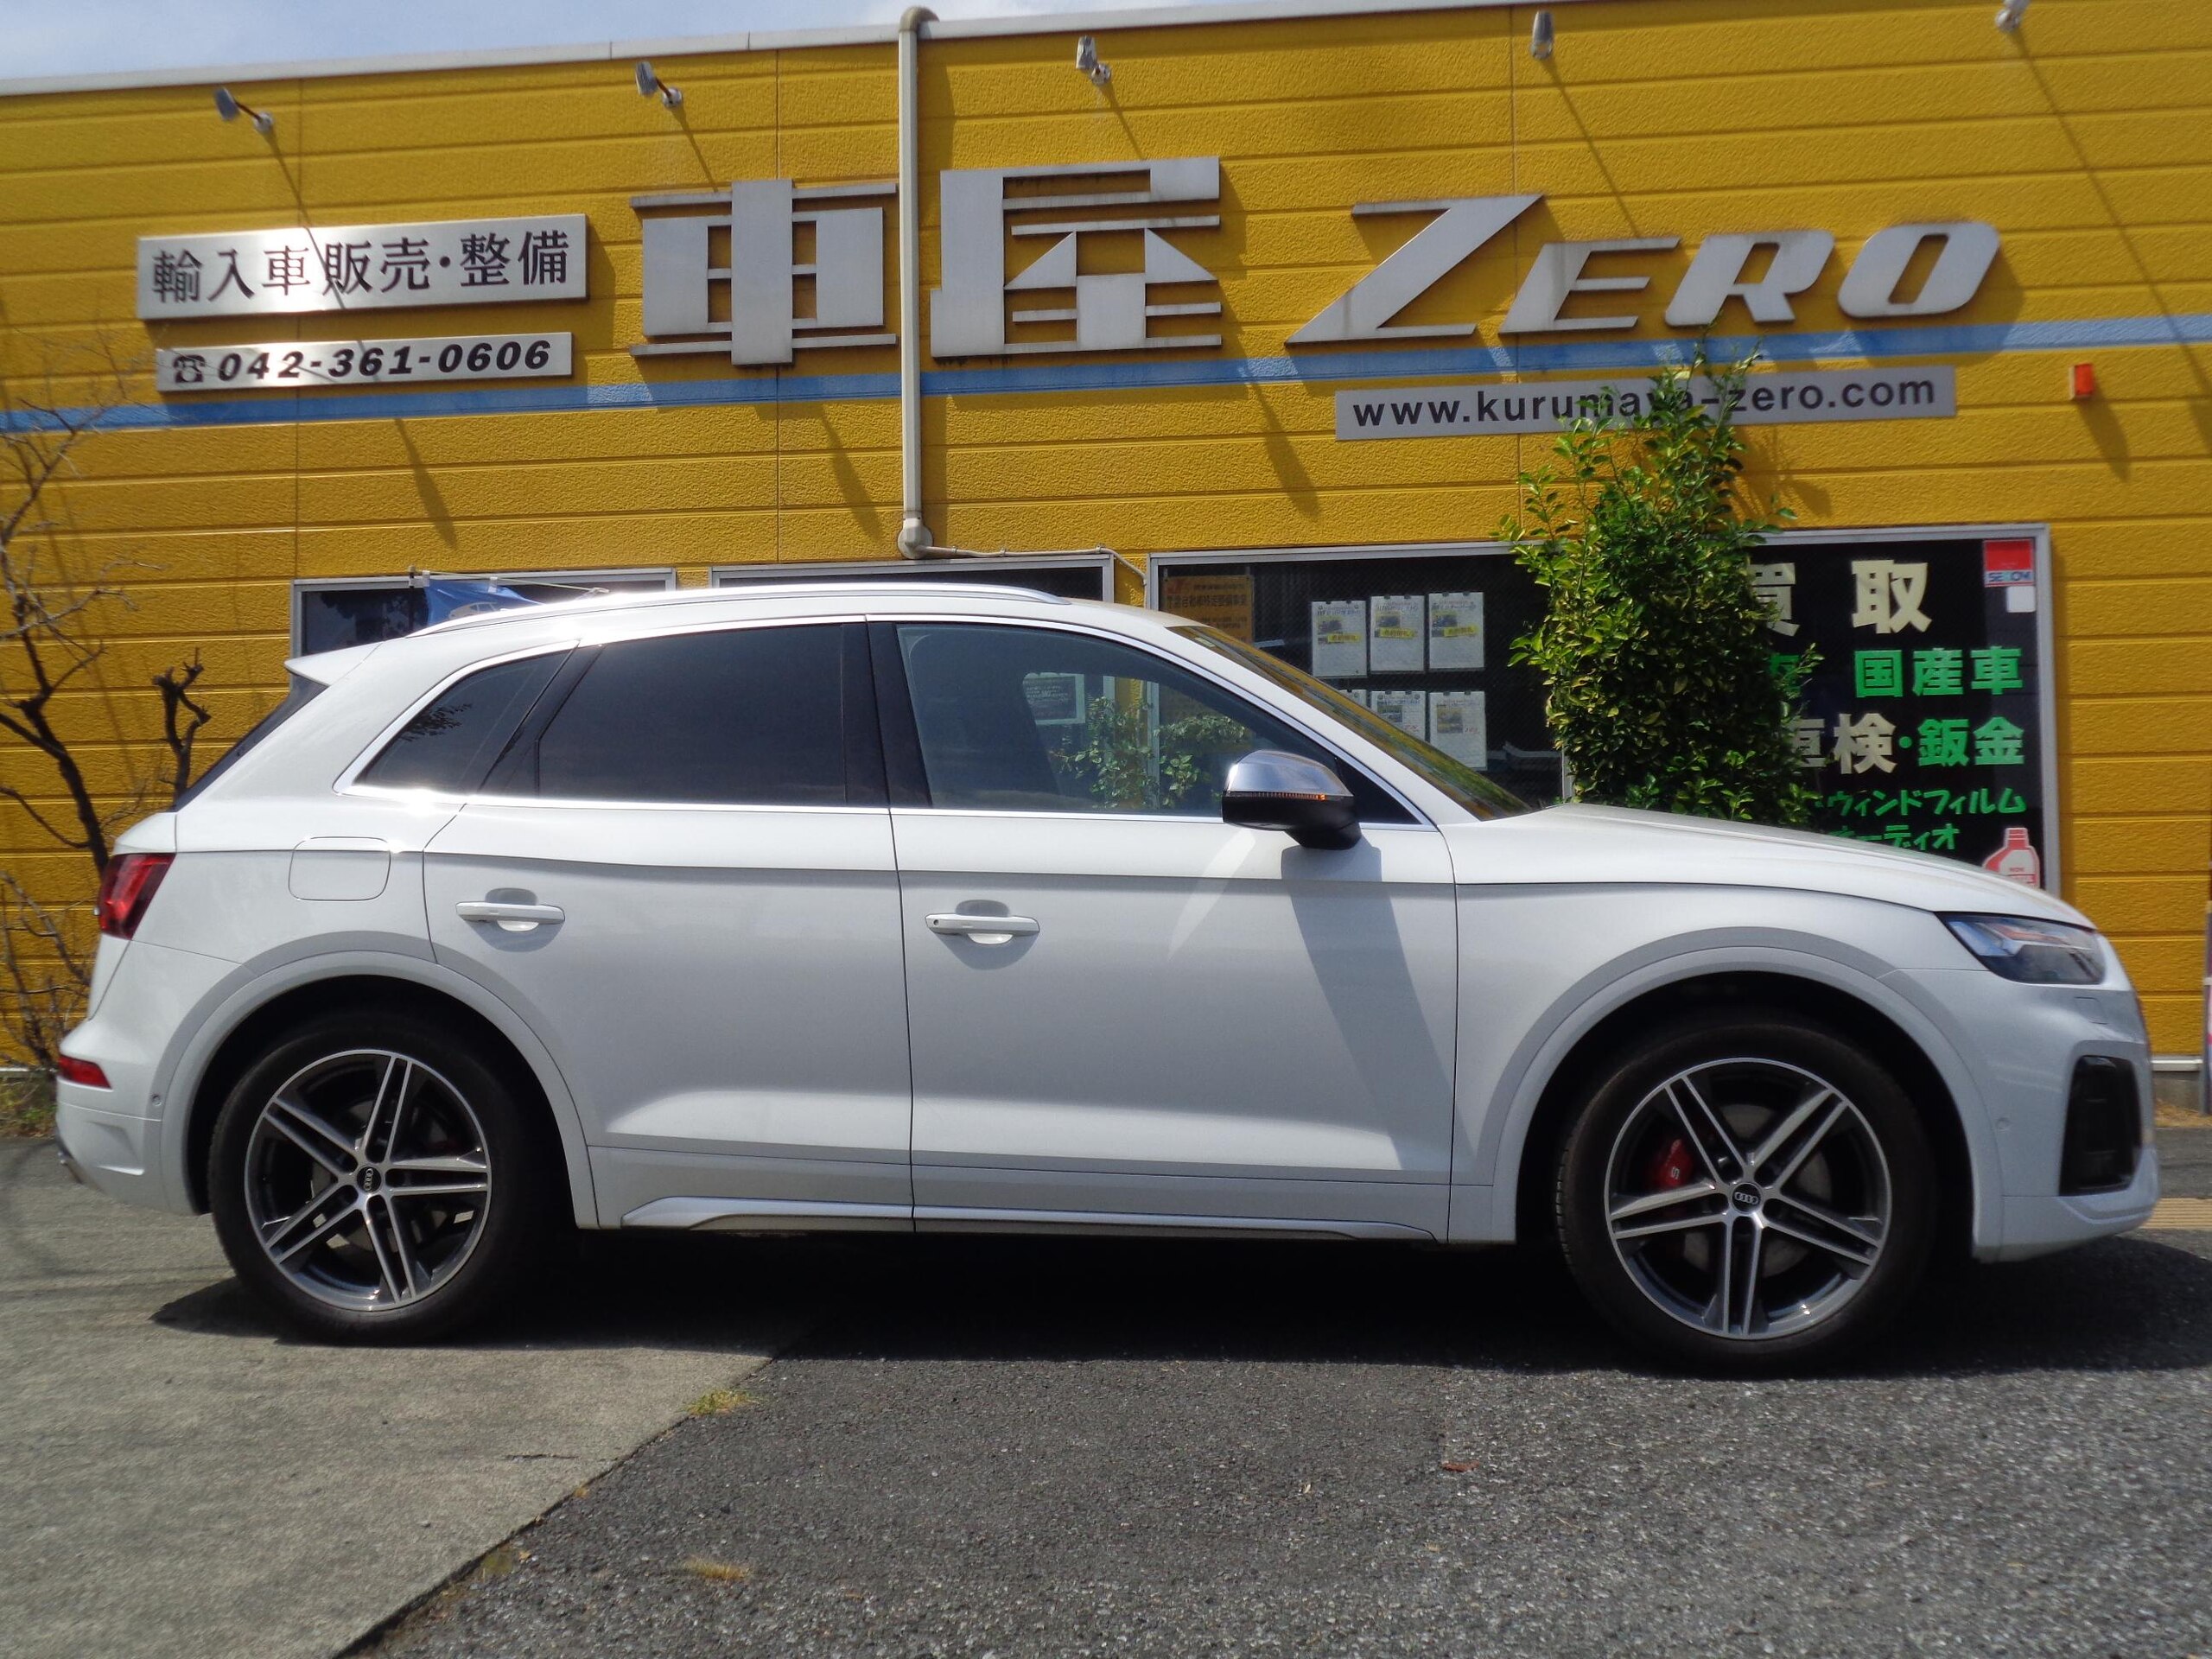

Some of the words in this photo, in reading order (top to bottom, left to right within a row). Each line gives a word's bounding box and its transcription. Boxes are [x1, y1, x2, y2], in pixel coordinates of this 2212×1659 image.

[151, 229, 570, 304] 輸入車販売・整備
[1284, 194, 2000, 346] ZERO
[217, 340, 552, 382] 042-361-0606
[1351, 375, 1936, 428] www.kuruma-zero.com
[1853, 645, 2024, 697] 国産車
